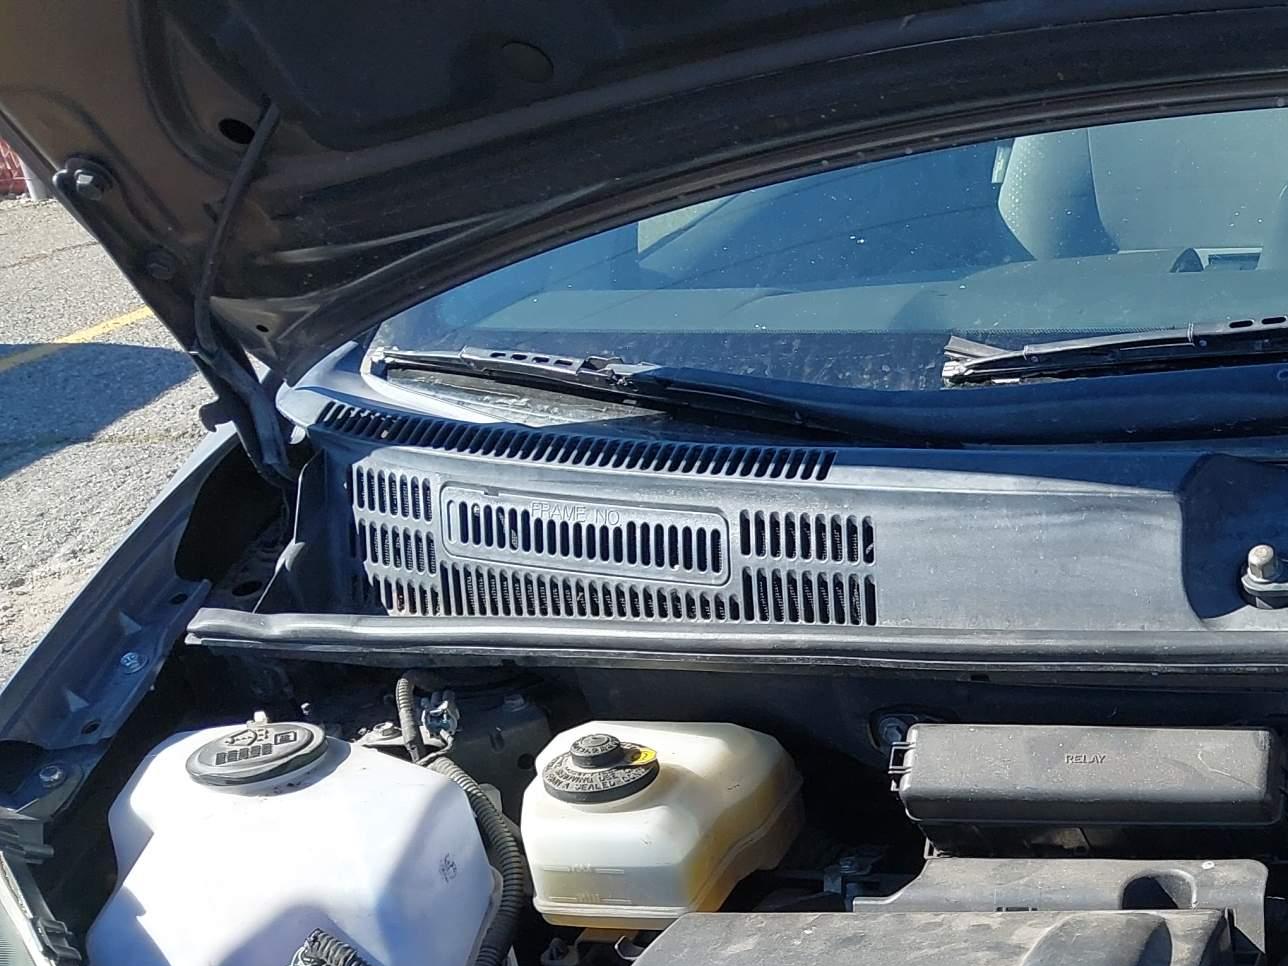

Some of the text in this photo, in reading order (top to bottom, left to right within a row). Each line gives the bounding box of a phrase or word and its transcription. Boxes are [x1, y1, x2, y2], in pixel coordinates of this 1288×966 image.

[530, 502, 623, 527] FRAME NO.
[1064, 754, 1107, 765] RELAY
